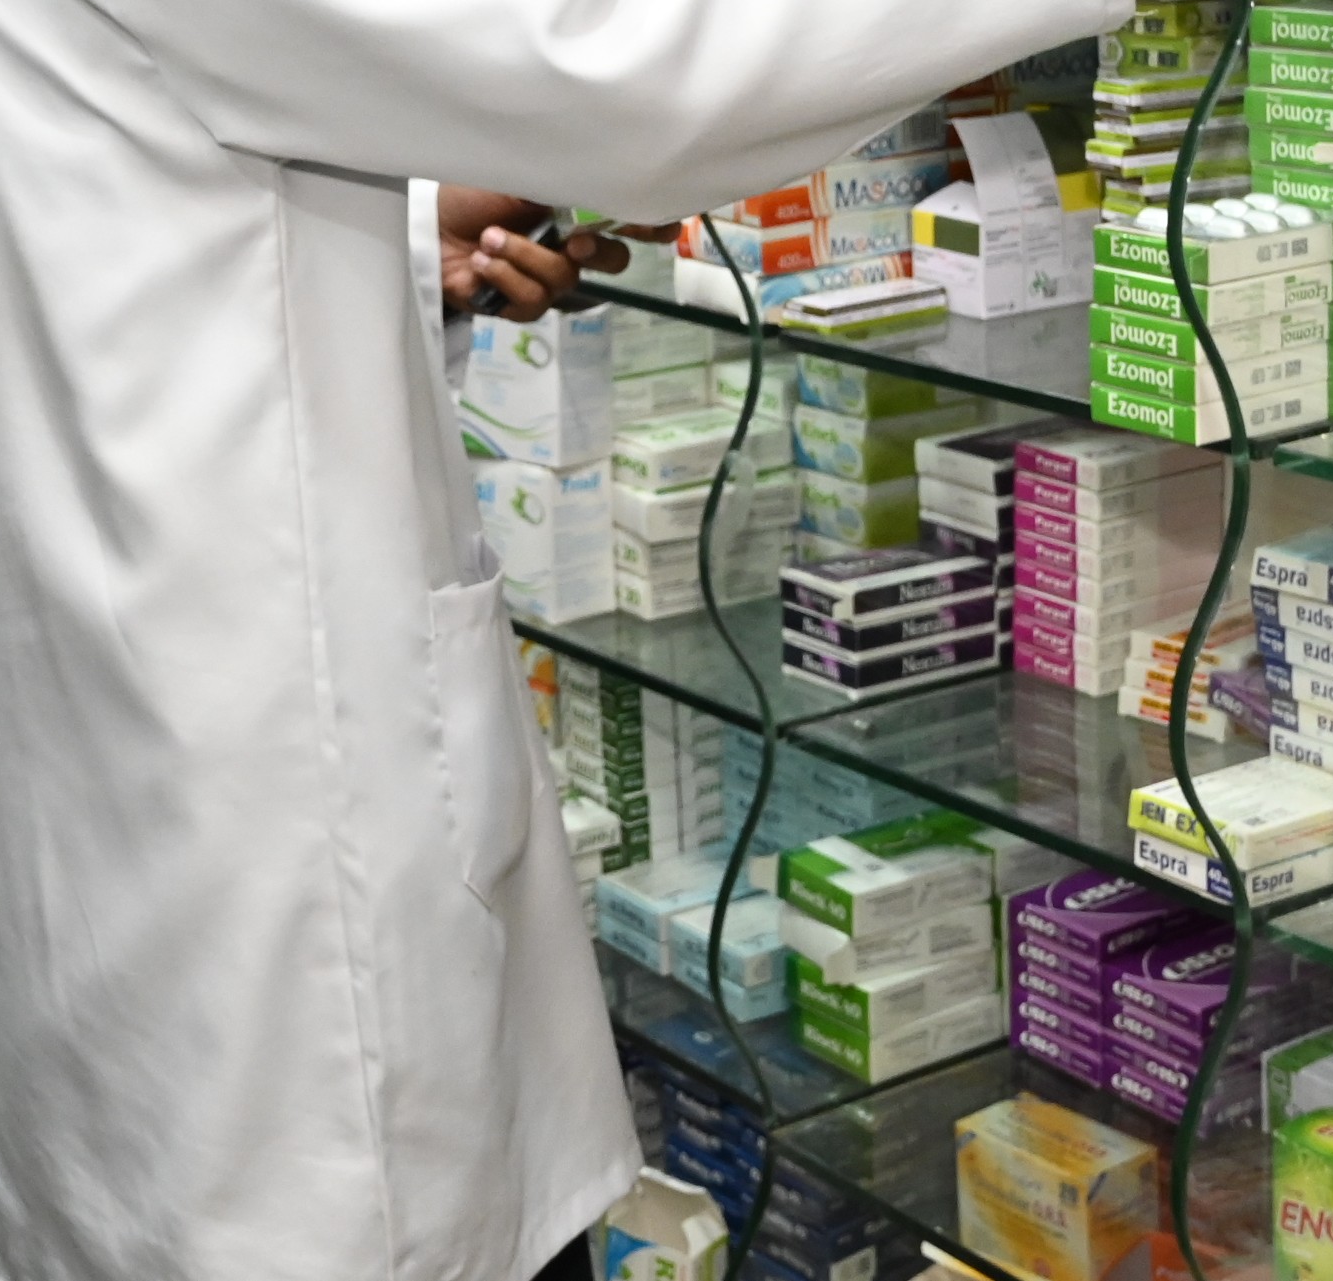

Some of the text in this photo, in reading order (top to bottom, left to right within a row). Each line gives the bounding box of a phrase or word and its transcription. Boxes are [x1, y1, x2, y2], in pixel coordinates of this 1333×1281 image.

[1110, 328, 1178, 354] Ezomol
[1107, 399, 1173, 428] Ezomol
[1256, 558, 1309, 589] Espra
[1139, 842, 1188, 876] Espra
